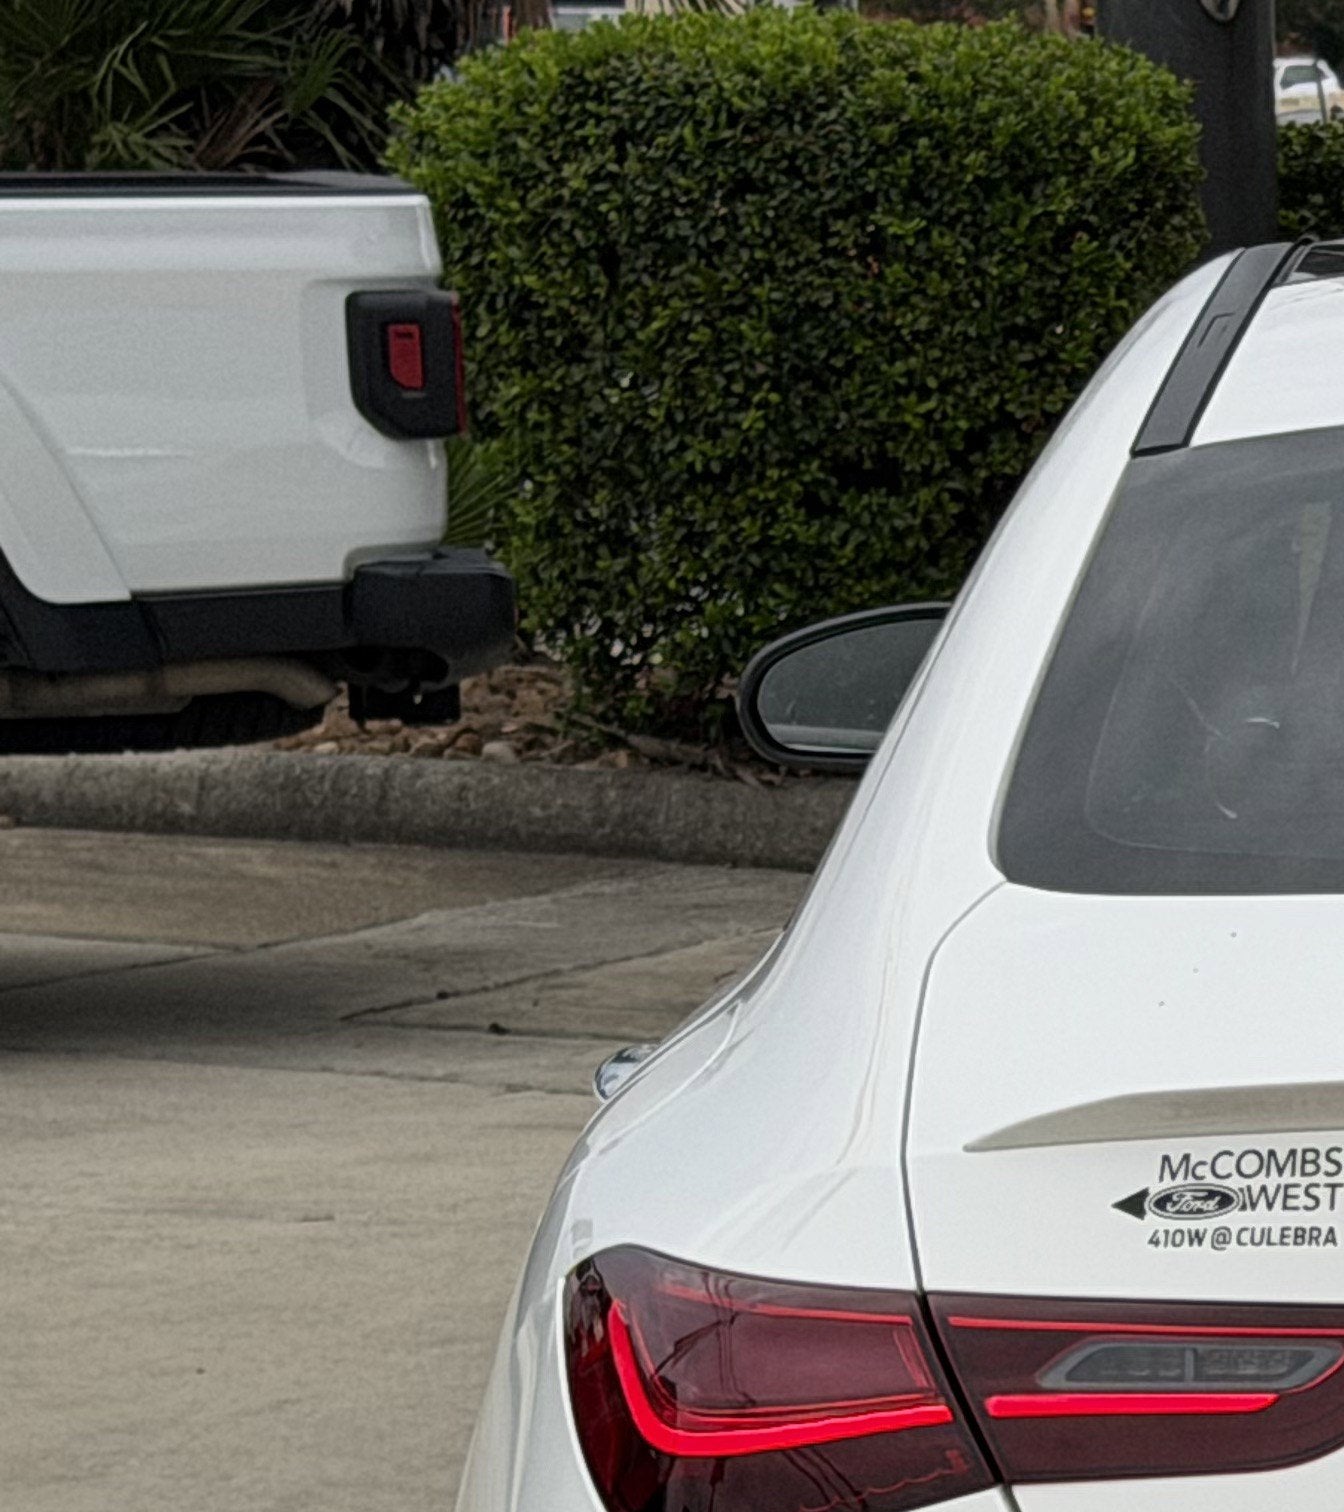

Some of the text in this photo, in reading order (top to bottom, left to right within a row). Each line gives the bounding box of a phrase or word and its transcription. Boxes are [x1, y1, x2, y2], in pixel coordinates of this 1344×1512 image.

[1158, 1146, 1344, 1183] McCOMBS
[1246, 1182, 1344, 1213] WEST
[1147, 1225, 1339, 1251] 410W @ CULEBRA
